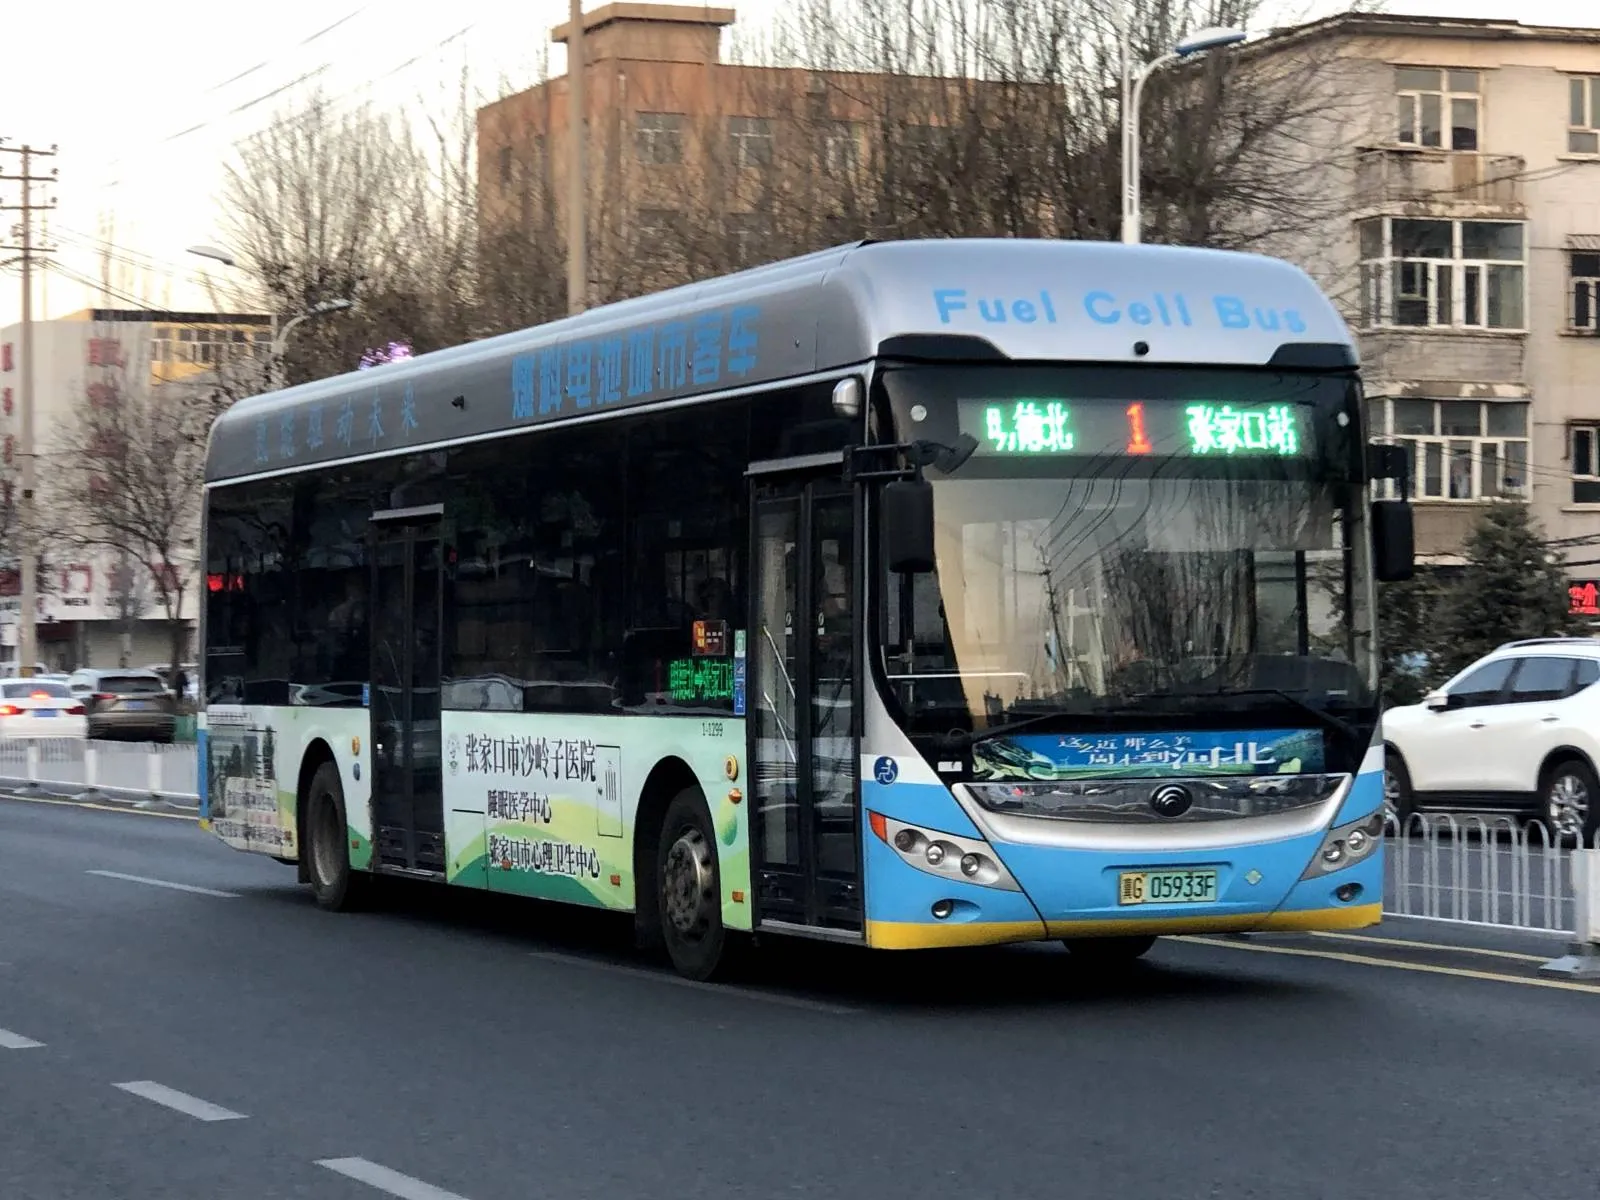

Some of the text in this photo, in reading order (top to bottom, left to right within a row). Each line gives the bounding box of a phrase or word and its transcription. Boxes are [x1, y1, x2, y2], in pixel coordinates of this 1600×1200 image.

[933, 288, 1307, 333] Fuel Cell Bus
[1126, 402, 1153, 455] 1
[1185, 404, 1297, 454] 张家口站
[465, 733, 596, 782] 张家口市沙岭子医院
[487, 789, 552, 824] 睡眠医学中心
[489, 834, 601, 879] 张家口市心理卫生中心
